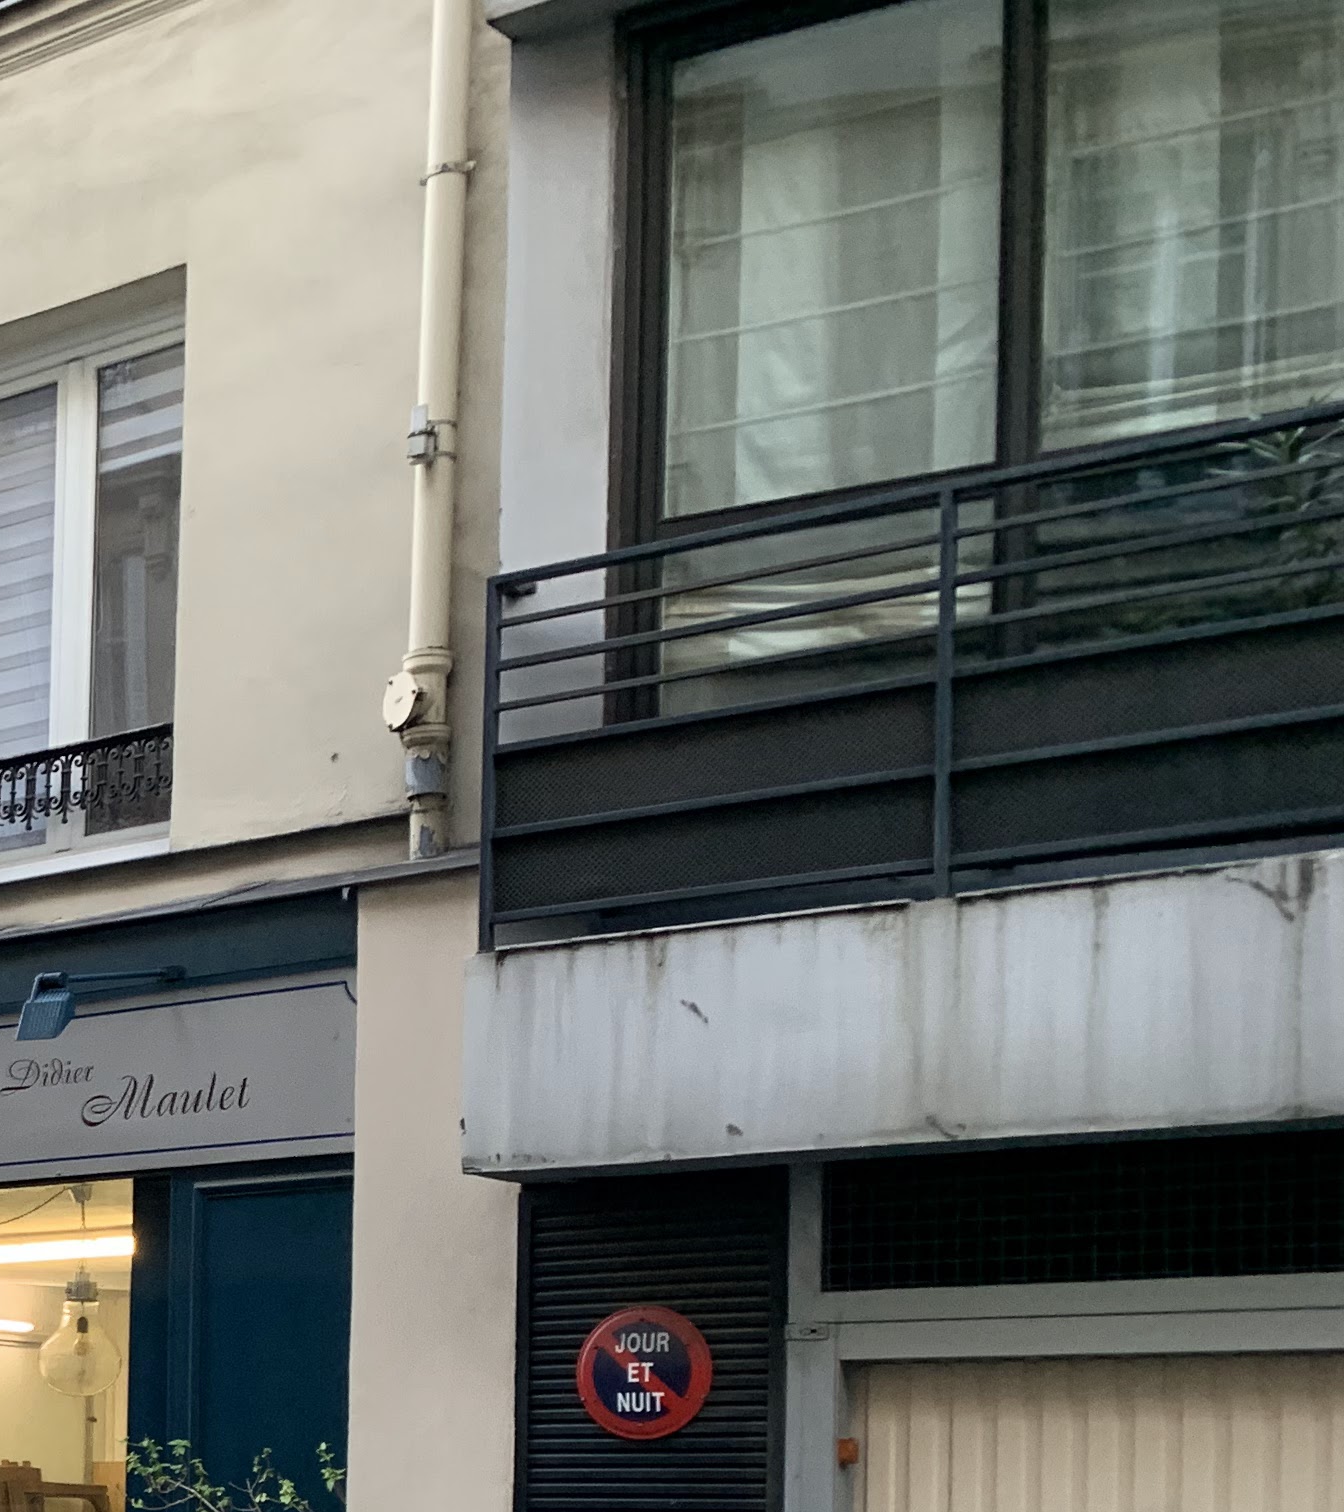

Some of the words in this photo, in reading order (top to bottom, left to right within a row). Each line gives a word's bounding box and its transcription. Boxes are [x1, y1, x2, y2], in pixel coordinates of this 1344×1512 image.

[0, 1057, 95, 1096] Didier
[80, 1070, 251, 1128] Maulet
[615, 1331, 670, 1354] JOUR
[627, 1361, 654, 1383] ET
[616, 1391, 665, 1413] NUIT
